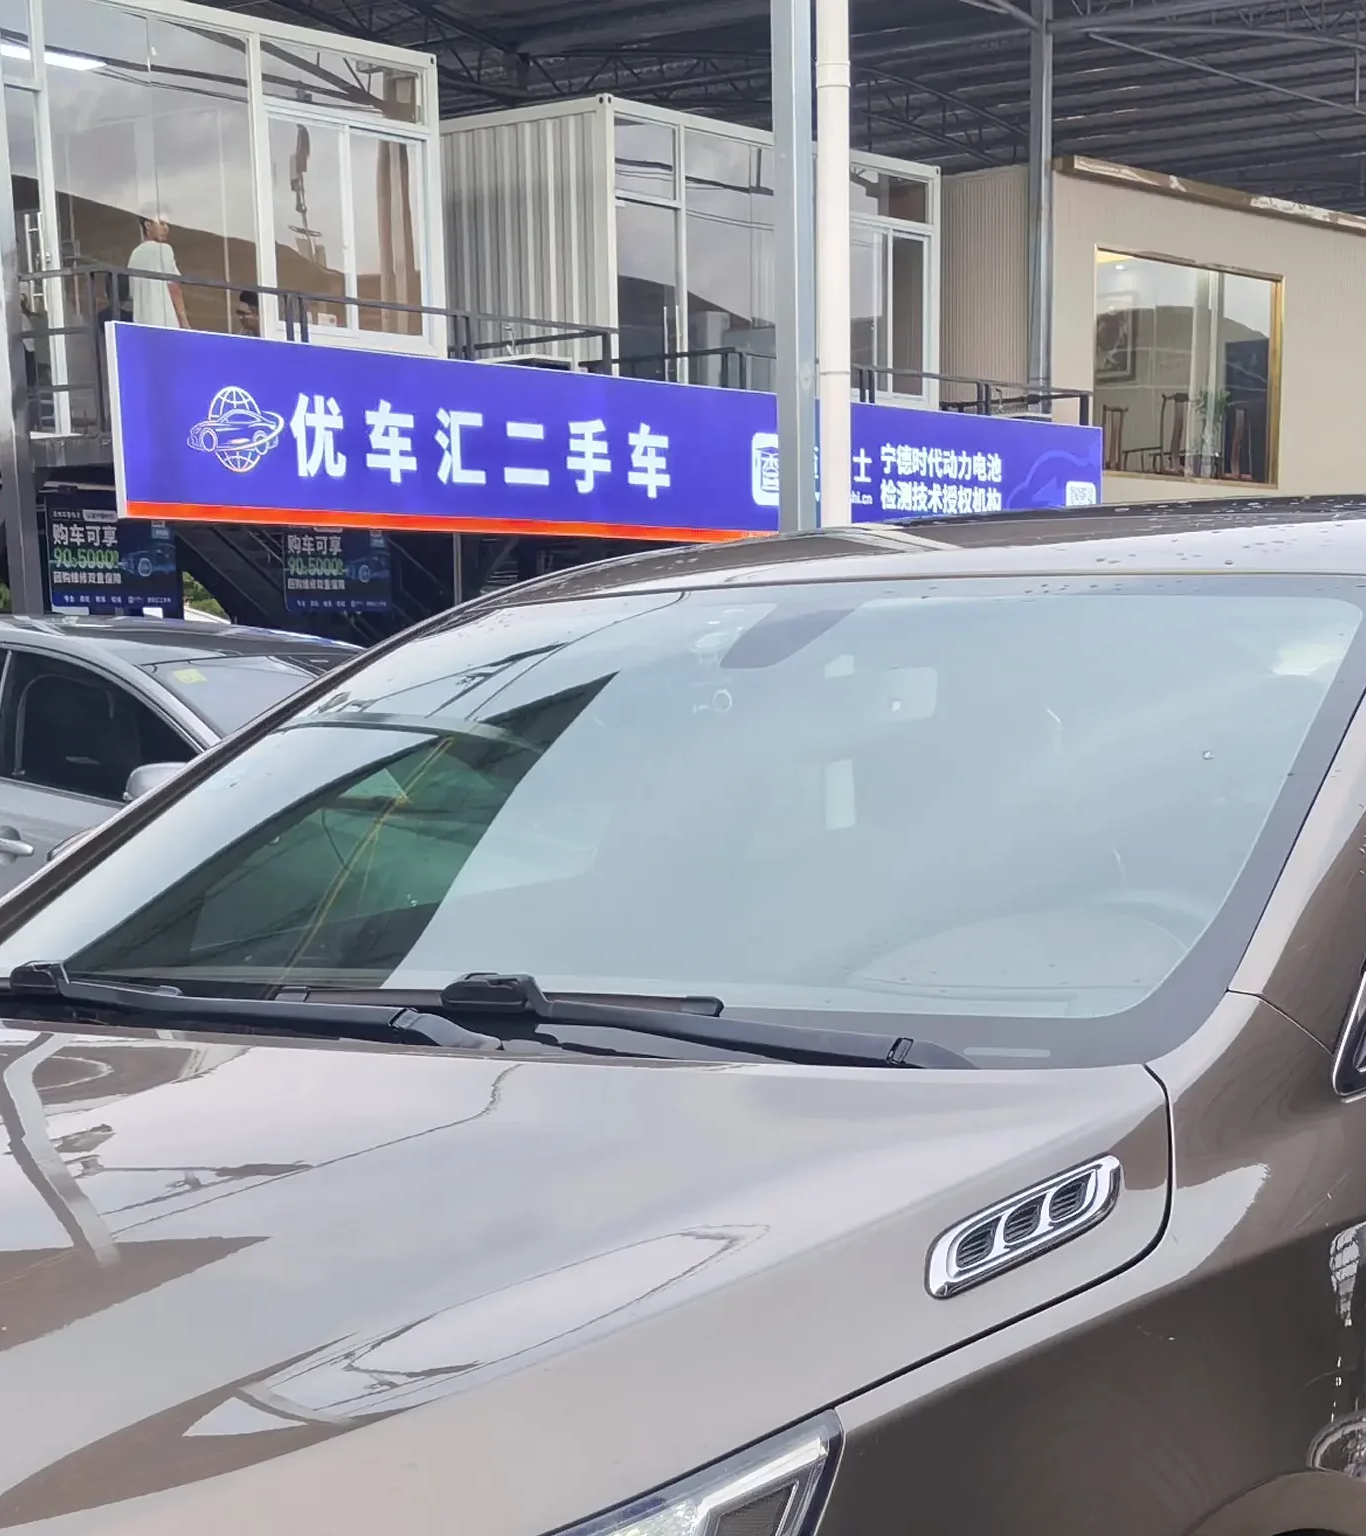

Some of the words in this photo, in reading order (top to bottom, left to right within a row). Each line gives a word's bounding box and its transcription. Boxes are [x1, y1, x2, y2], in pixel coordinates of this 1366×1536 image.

[290, 392, 672, 499] 优车汇二手车
[880, 443, 1003, 483] 宁德时代动力电池
[880, 479, 1003, 515] 检测技术授权机构
[52, 523, 118, 547] 购车可享
[287, 534, 342, 555] 购车可享
